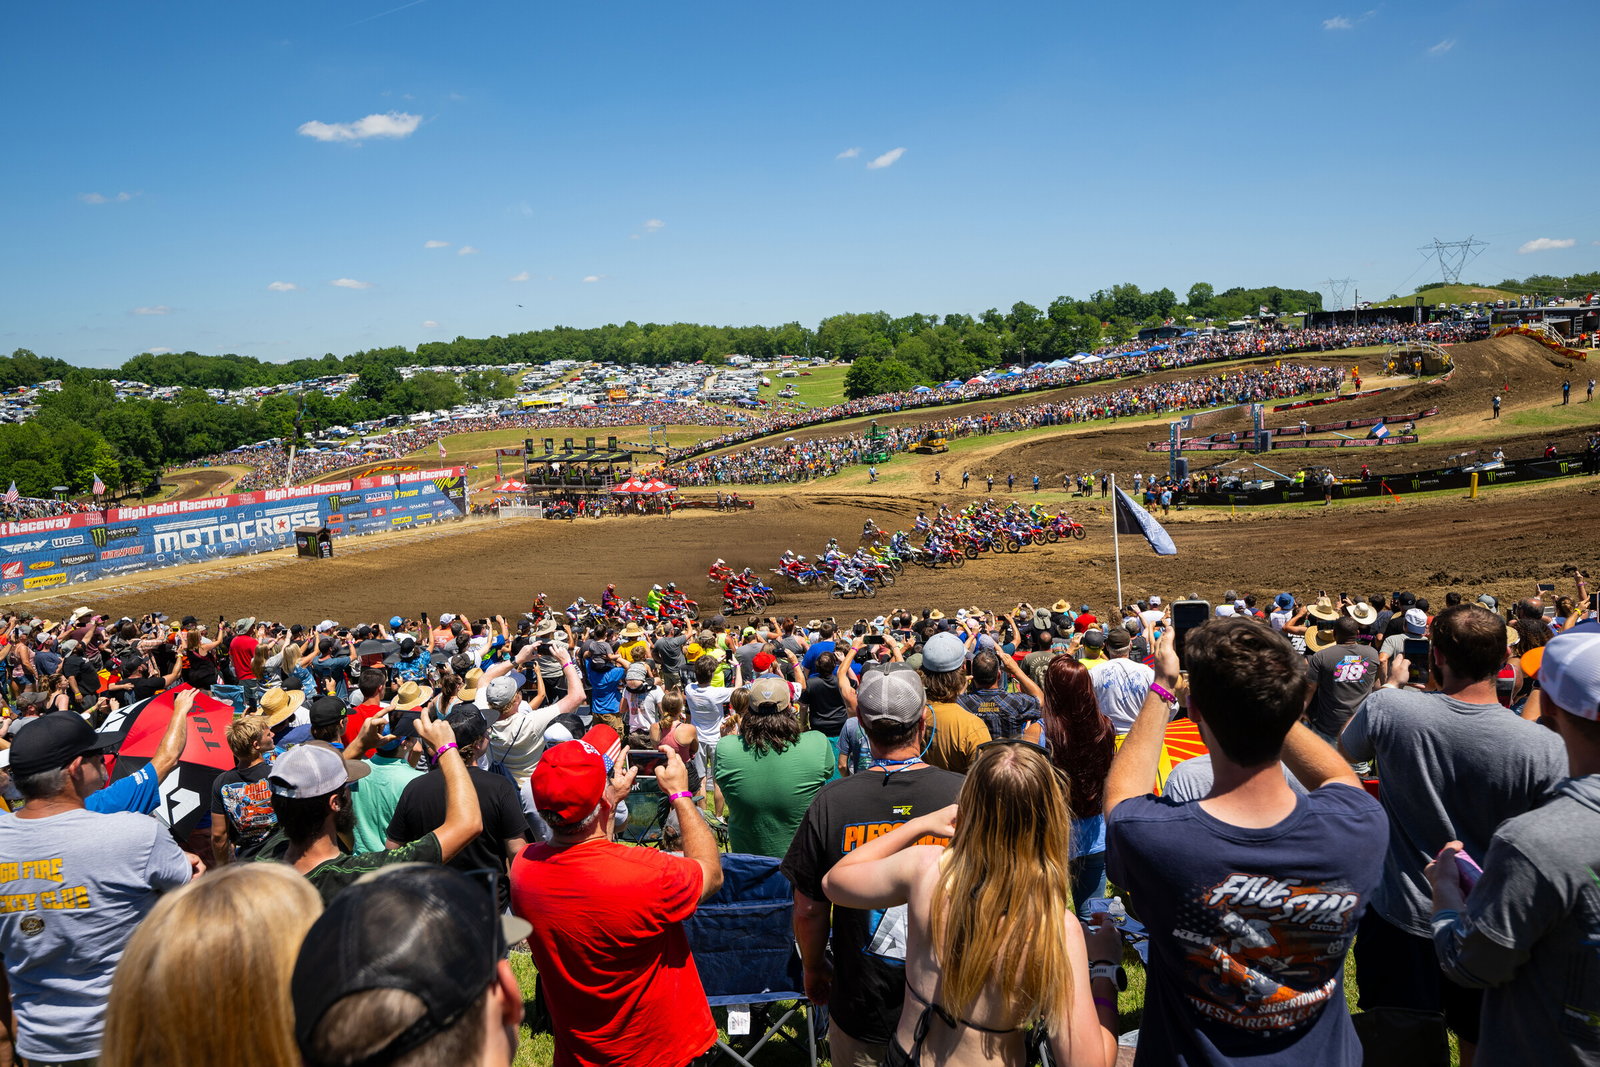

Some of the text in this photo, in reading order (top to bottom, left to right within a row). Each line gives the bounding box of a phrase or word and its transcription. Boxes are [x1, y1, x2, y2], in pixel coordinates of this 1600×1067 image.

[400, 472, 419, 482] Point
[420, 469, 453, 480] Raceway
[264, 481, 352, 500] High Point Raceway
[118, 497, 228, 520] High Point Raceway
[220, 510, 262, 522] PRO
[8, 517, 72, 534] Raceway
[107, 527, 138, 535] MONSTER
[153, 510, 320, 554] MOTOCROSS
[52, 535, 83, 548] WPS
[61, 555, 89, 564] TRIUMPH
[22, 858, 64, 883] FIRE
[40, 886, 90, 909] CLUB
[1209, 874, 1302, 908] FIVE
[1270, 894, 1358, 923] STAR
